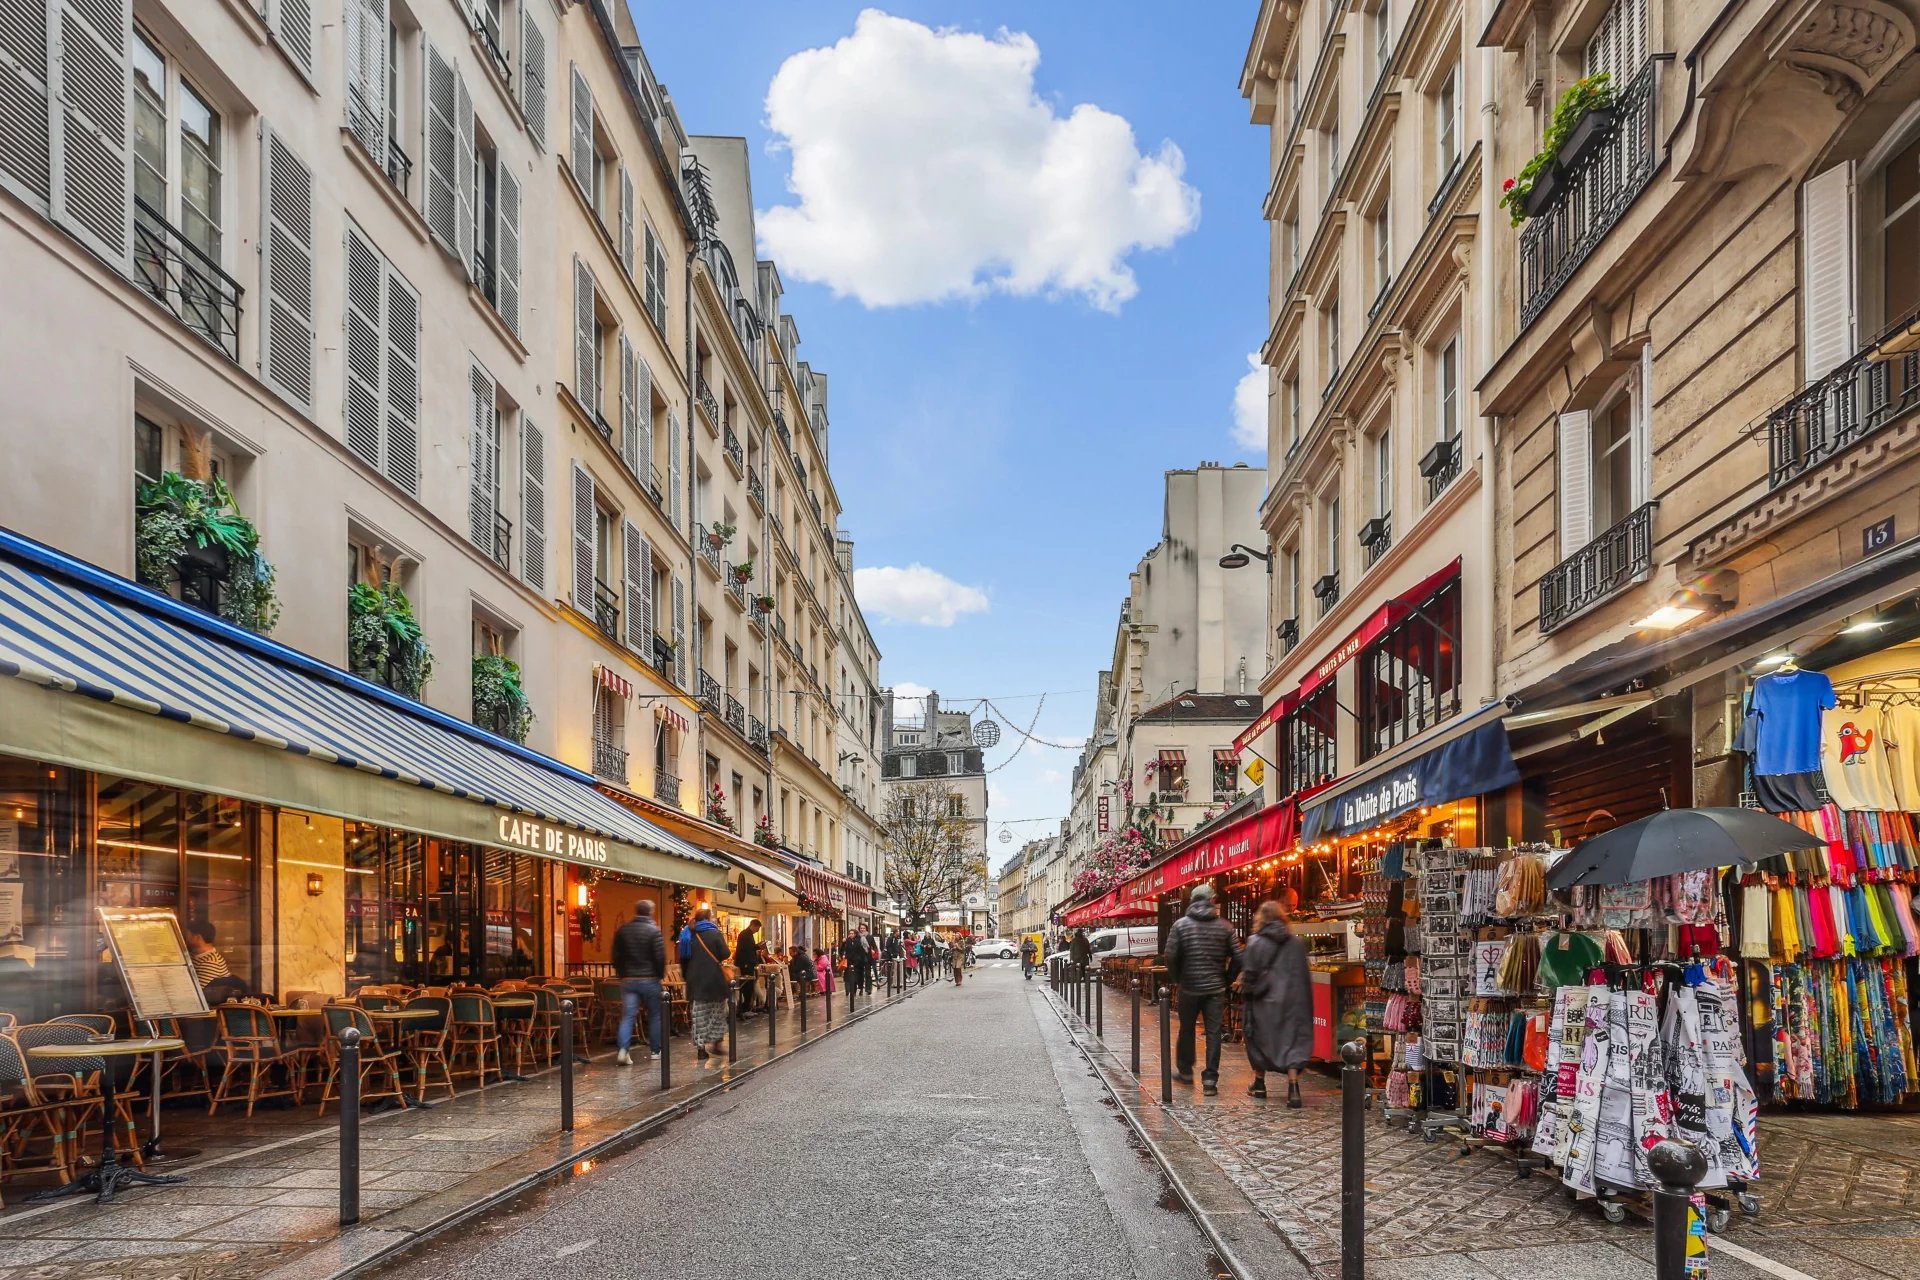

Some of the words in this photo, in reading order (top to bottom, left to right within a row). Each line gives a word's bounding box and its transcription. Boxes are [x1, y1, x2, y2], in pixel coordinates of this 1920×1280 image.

[1867, 521, 1888, 549] 13
[1319, 656, 1337, 679] FRUITS
[1338, 649, 1346, 663] DE
[1346, 638, 1359, 656] MER
[1098, 798, 1108, 831] HOTEL
[1344, 802, 1354, 827] La
[1355, 793, 1378, 823] Voûte
[1380, 786, 1391, 814] de
[1392, 773, 1417, 809] Paris
[499, 816, 540, 849] CAFE
[545, 828, 564, 854] DE
[568, 834, 607, 863] PARIS
[1194, 844, 1225, 872] ATLAS
